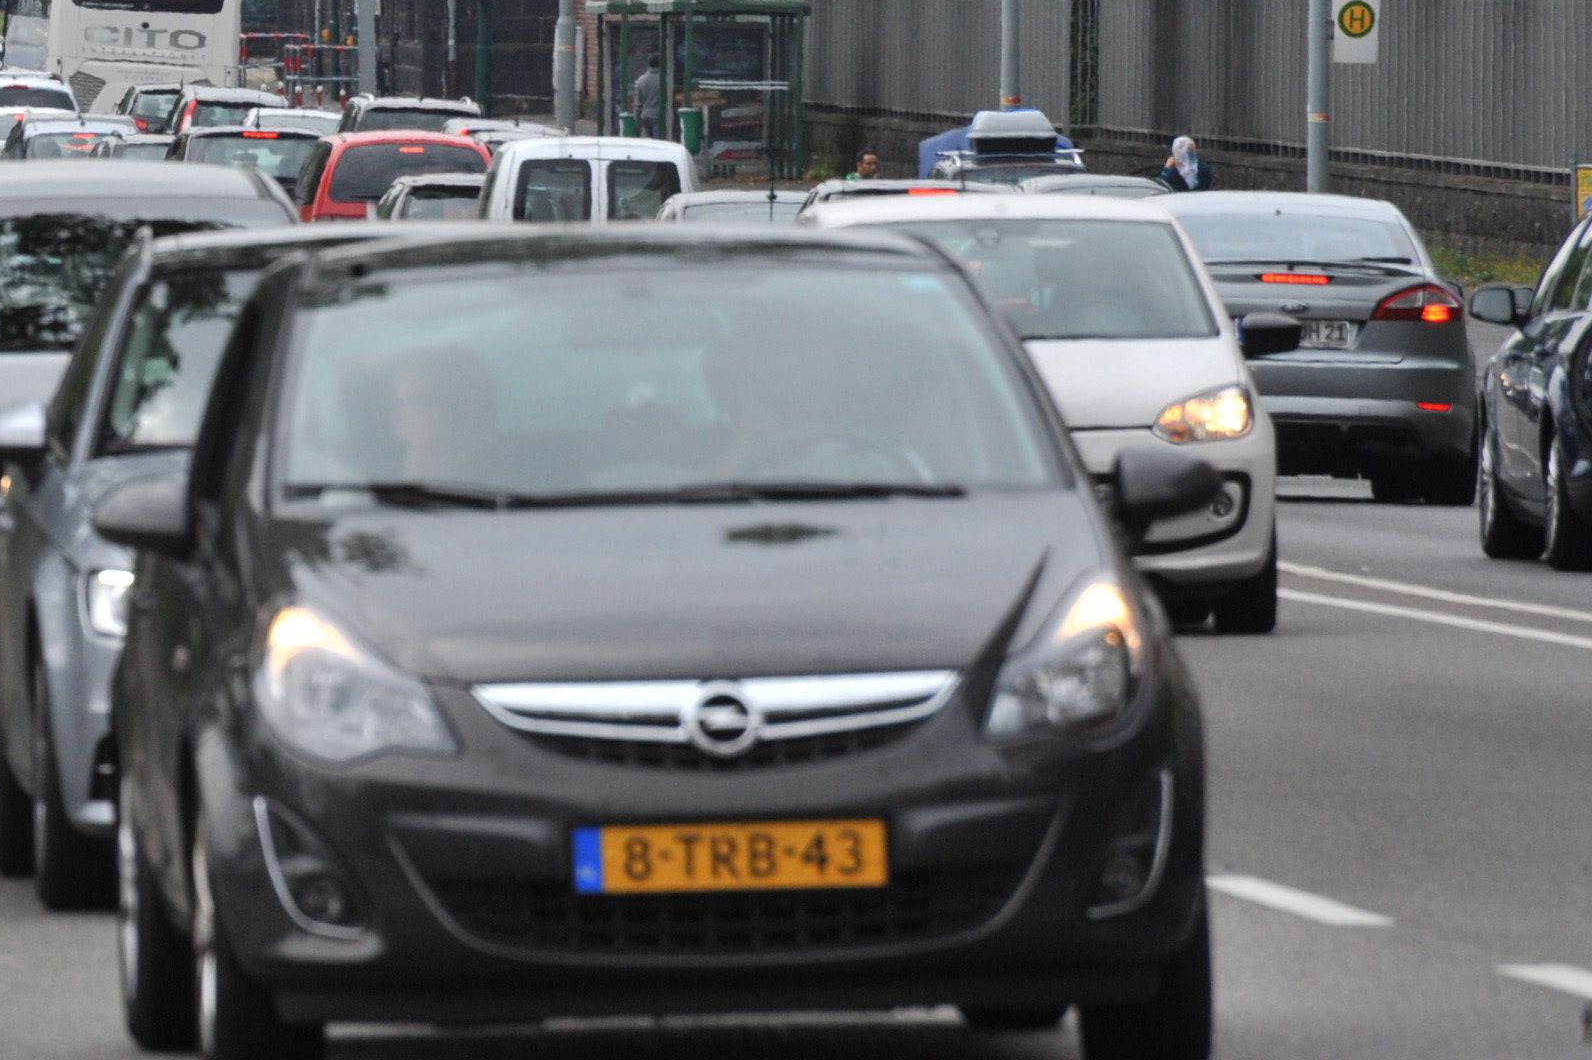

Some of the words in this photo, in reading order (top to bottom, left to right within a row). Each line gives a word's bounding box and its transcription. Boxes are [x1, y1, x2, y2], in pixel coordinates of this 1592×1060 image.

[1349, 9, 1365, 30] H
[83, 25, 207, 51] CITO
[1325, 322, 1345, 341] 21
[623, 829, 864, 883] 8-TRB-43
